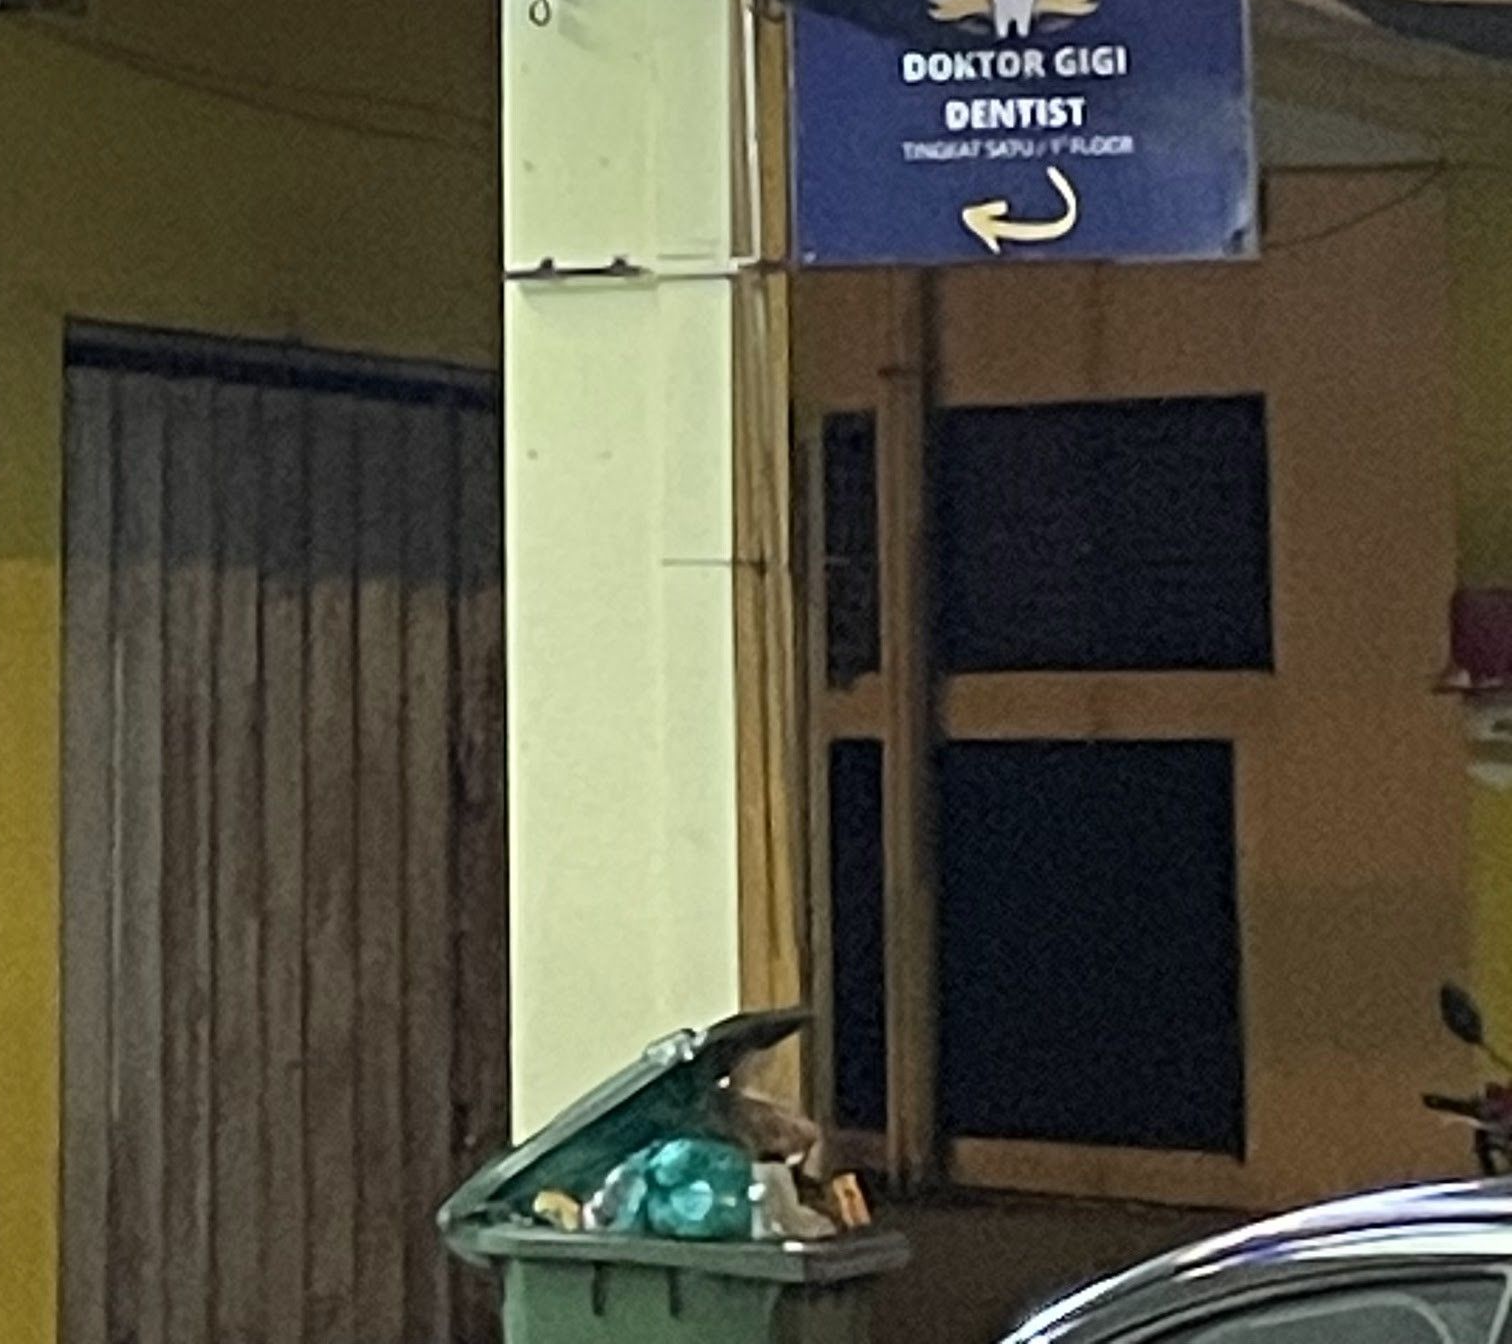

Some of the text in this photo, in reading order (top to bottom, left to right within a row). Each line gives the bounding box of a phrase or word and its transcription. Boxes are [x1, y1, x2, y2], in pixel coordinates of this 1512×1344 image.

[902, 45, 1127, 83] DOKTOR GIGI
[945, 96, 1086, 130] DENTIST
